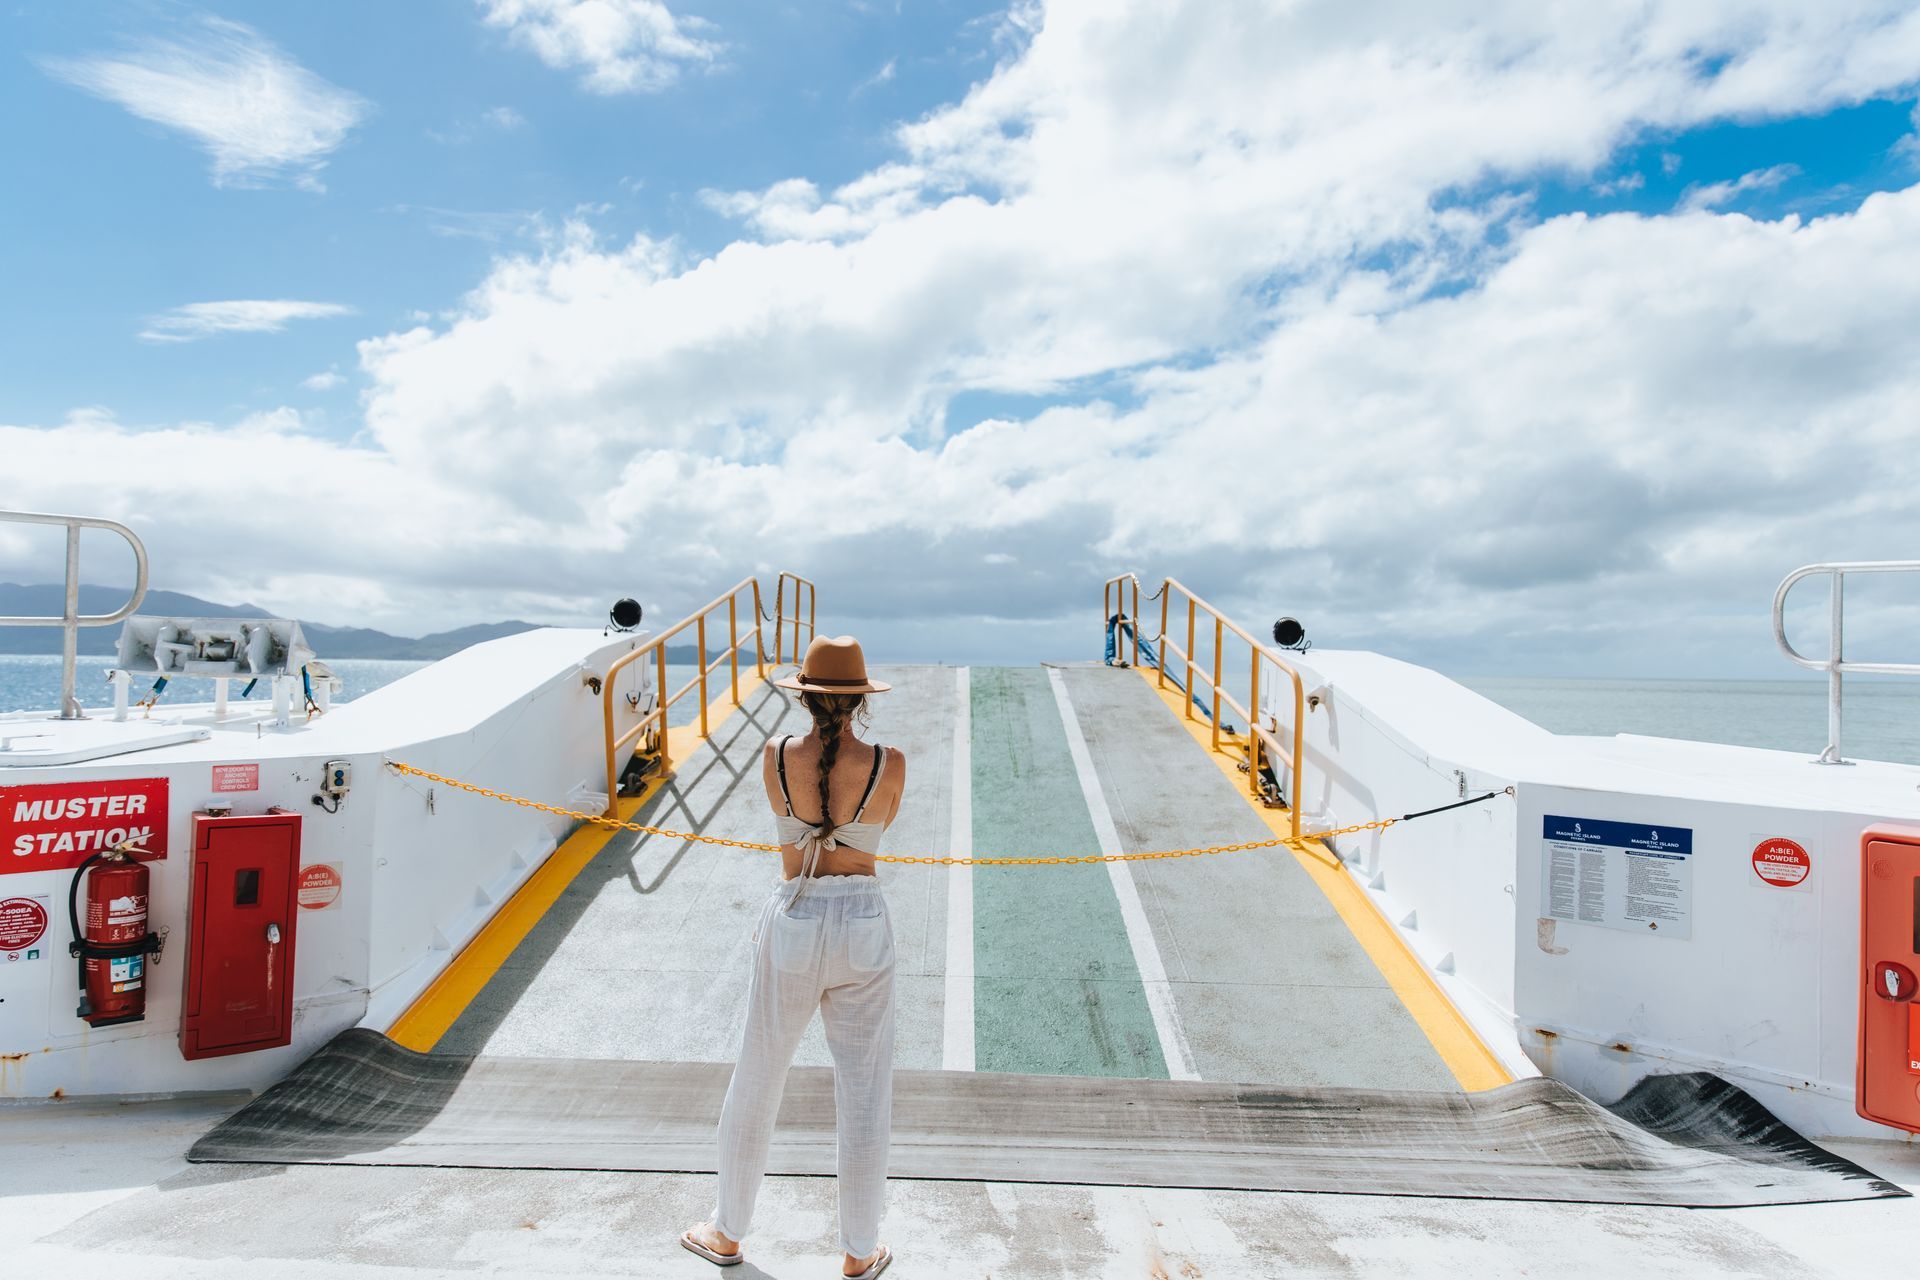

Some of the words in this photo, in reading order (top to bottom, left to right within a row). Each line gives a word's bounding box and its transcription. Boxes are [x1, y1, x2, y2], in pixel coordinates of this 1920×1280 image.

[13, 794, 147, 823] MUSTER
[1556, 830, 1581, 838] MAGNETIC
[12, 826, 150, 857] STATION
[1764, 853, 1799, 863] POWDER
[303, 879, 333, 887] POWDER
